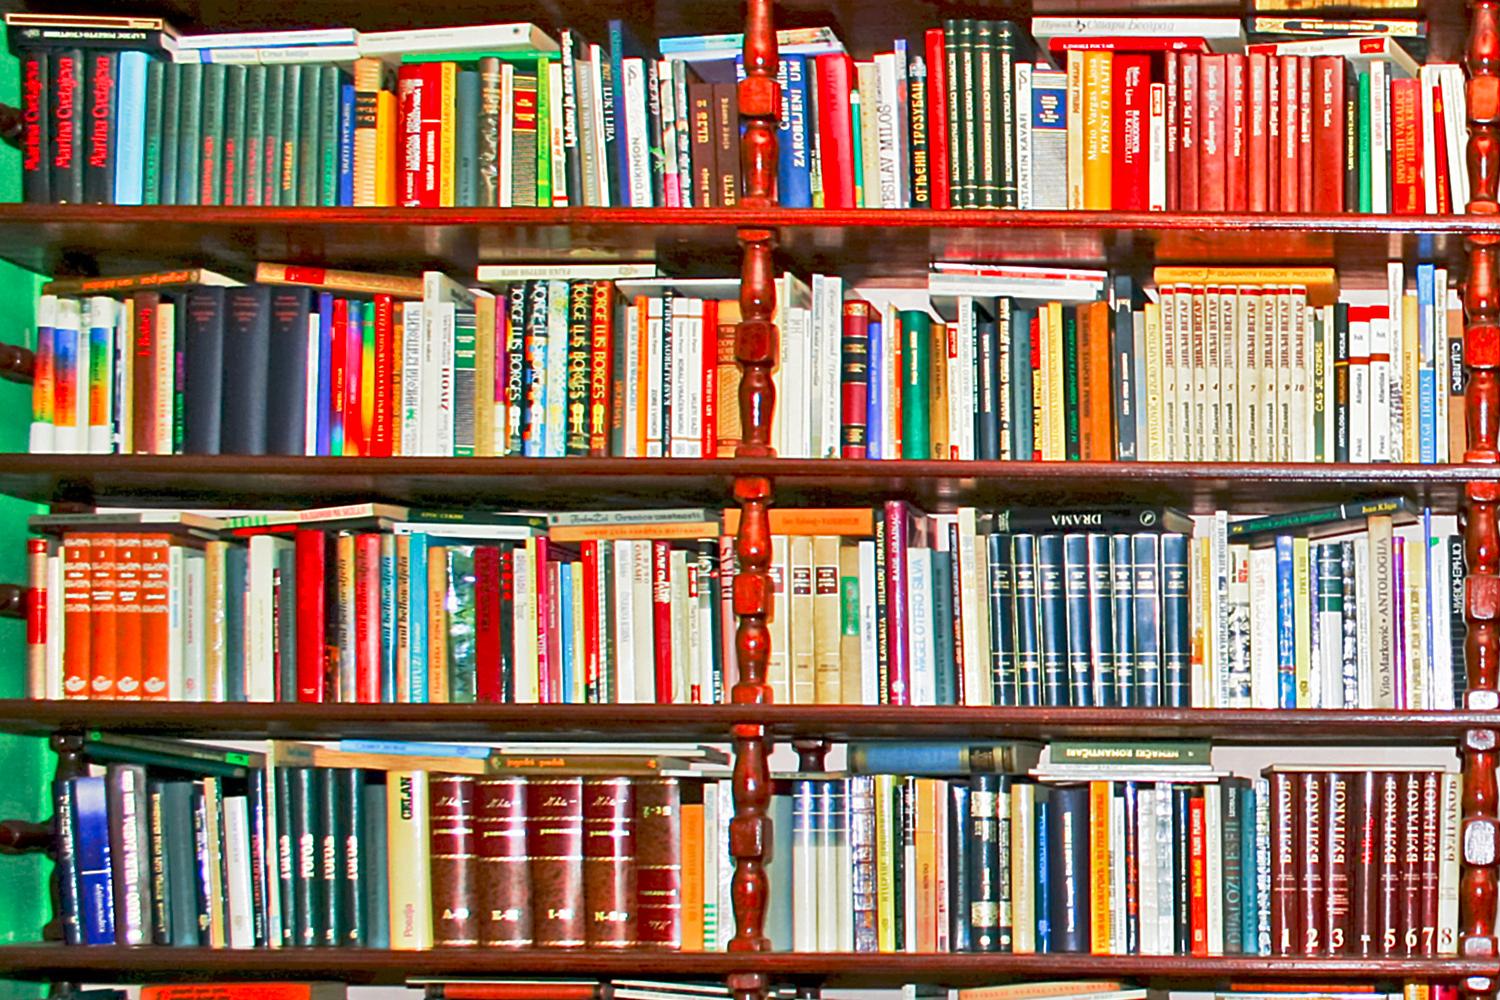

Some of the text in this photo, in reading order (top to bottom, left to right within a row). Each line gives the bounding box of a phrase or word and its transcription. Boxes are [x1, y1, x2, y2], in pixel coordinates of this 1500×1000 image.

[564, 69, 573, 93] srce
[564, 108, 577, 147] Ljubav
[565, 96, 576, 106] je
[603, 87, 615, 142] LUK LIRA
[789, 61, 805, 167] ZAROBLJENI UM
[1088, 58, 1100, 160] Mario Vargas Ljosa
[1405, 89, 1415, 120] KRULA
[25, 125, 40, 170] Marina
[56, 122, 72, 167] Marina
[91, 120, 108, 167] Marina
[632, 137, 644, 189] DIKINSON
[910, 81, 928, 201] ОГЊЕНИ ТРОЗУБАЦ
[1100, 115, 1110, 153] POVEST
[1395, 90, 1407, 184] ISPOVESTI VARALICE
[509, 288, 523, 401] JORGE LUIS BORGES
[571, 284, 586, 399] JORGE LUIS BORGES
[593, 285, 607, 399] JORGE LUIS BORGES
[1338, 407, 1346, 447] ANTOLOGIJA
[1051, 513, 1103, 526] DRAMA
[398, 556, 408, 585] djela
[399, 586, 408, 618] bellow
[875, 521, 887, 661] KAVABATA HILJADU ŽDRALOVA
[912, 559, 927, 672] MIGEL OTERO SILVA
[1377, 537, 1390, 698] Vito Marković ANTOLOGIJA
[401, 777, 414, 937] Poezija CELAN
[1279, 780, 1292, 863] БУЛГАКОВ
[1306, 780, 1320, 948] 2 БУЛГАКОВ
[1330, 780, 1346, 947] 3 БУЛГАКОВ
[1384, 780, 1397, 947] 5 БУЛГАКОВ
[1406, 780, 1419, 948] 6 БУЛГАКОВ
[1421, 779, 1436, 947] 7 БУЛГАКОВ
[1441, 780, 1458, 945] 8 БУЛГАКОВ
